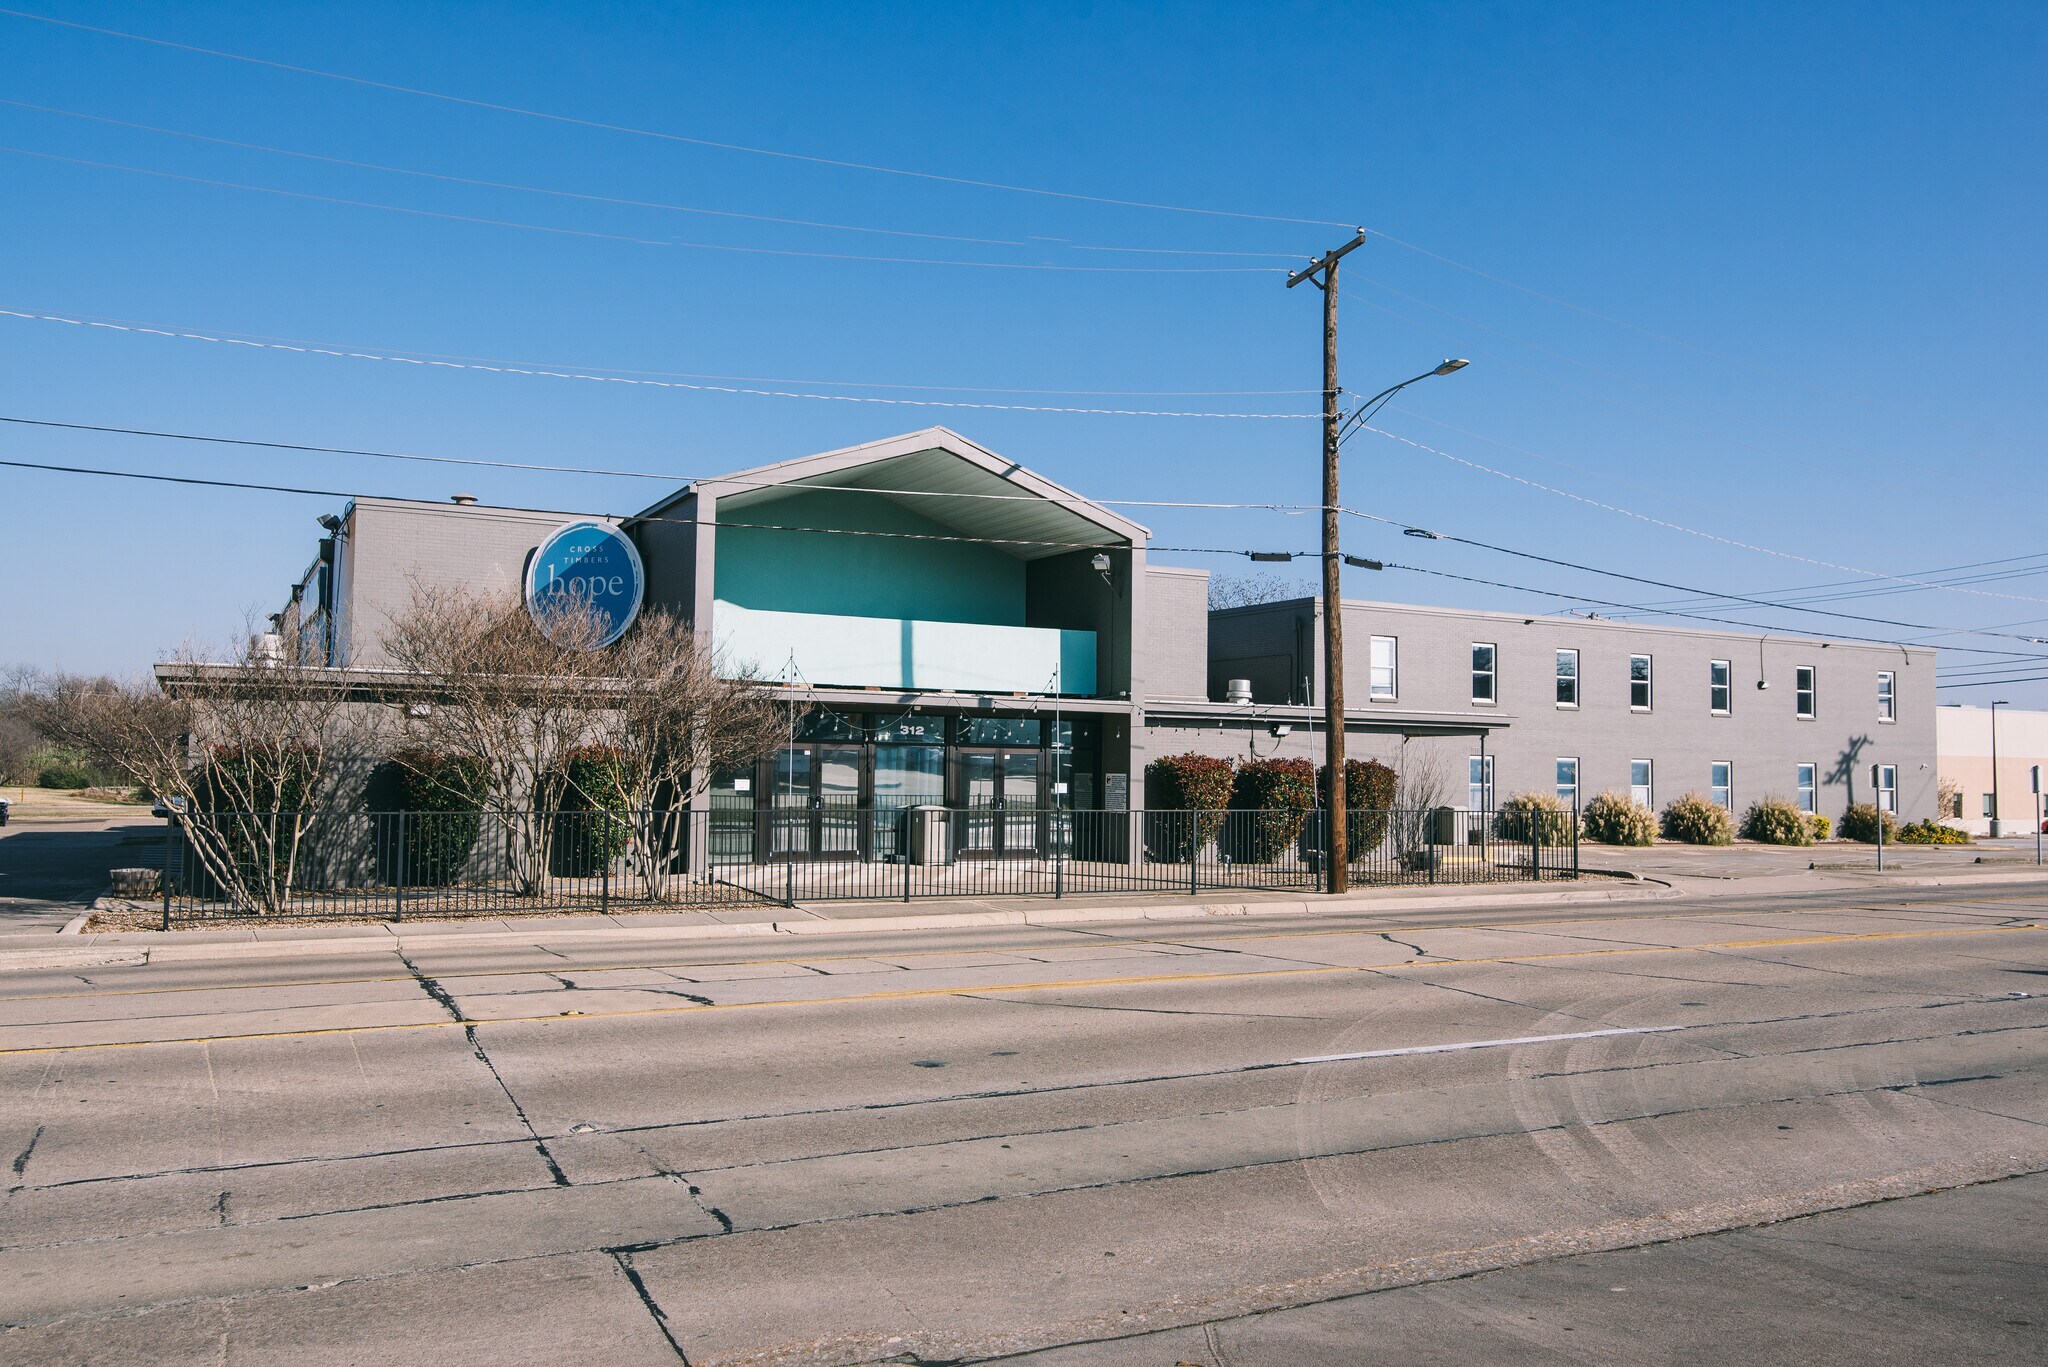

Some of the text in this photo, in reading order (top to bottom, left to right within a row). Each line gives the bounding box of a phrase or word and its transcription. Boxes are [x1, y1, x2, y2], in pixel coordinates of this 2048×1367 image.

[569, 545, 604, 553] CROSS
[563, 556, 609, 564] TIMBERS
[547, 564, 624, 603] hope
[900, 725, 925, 736] 312
